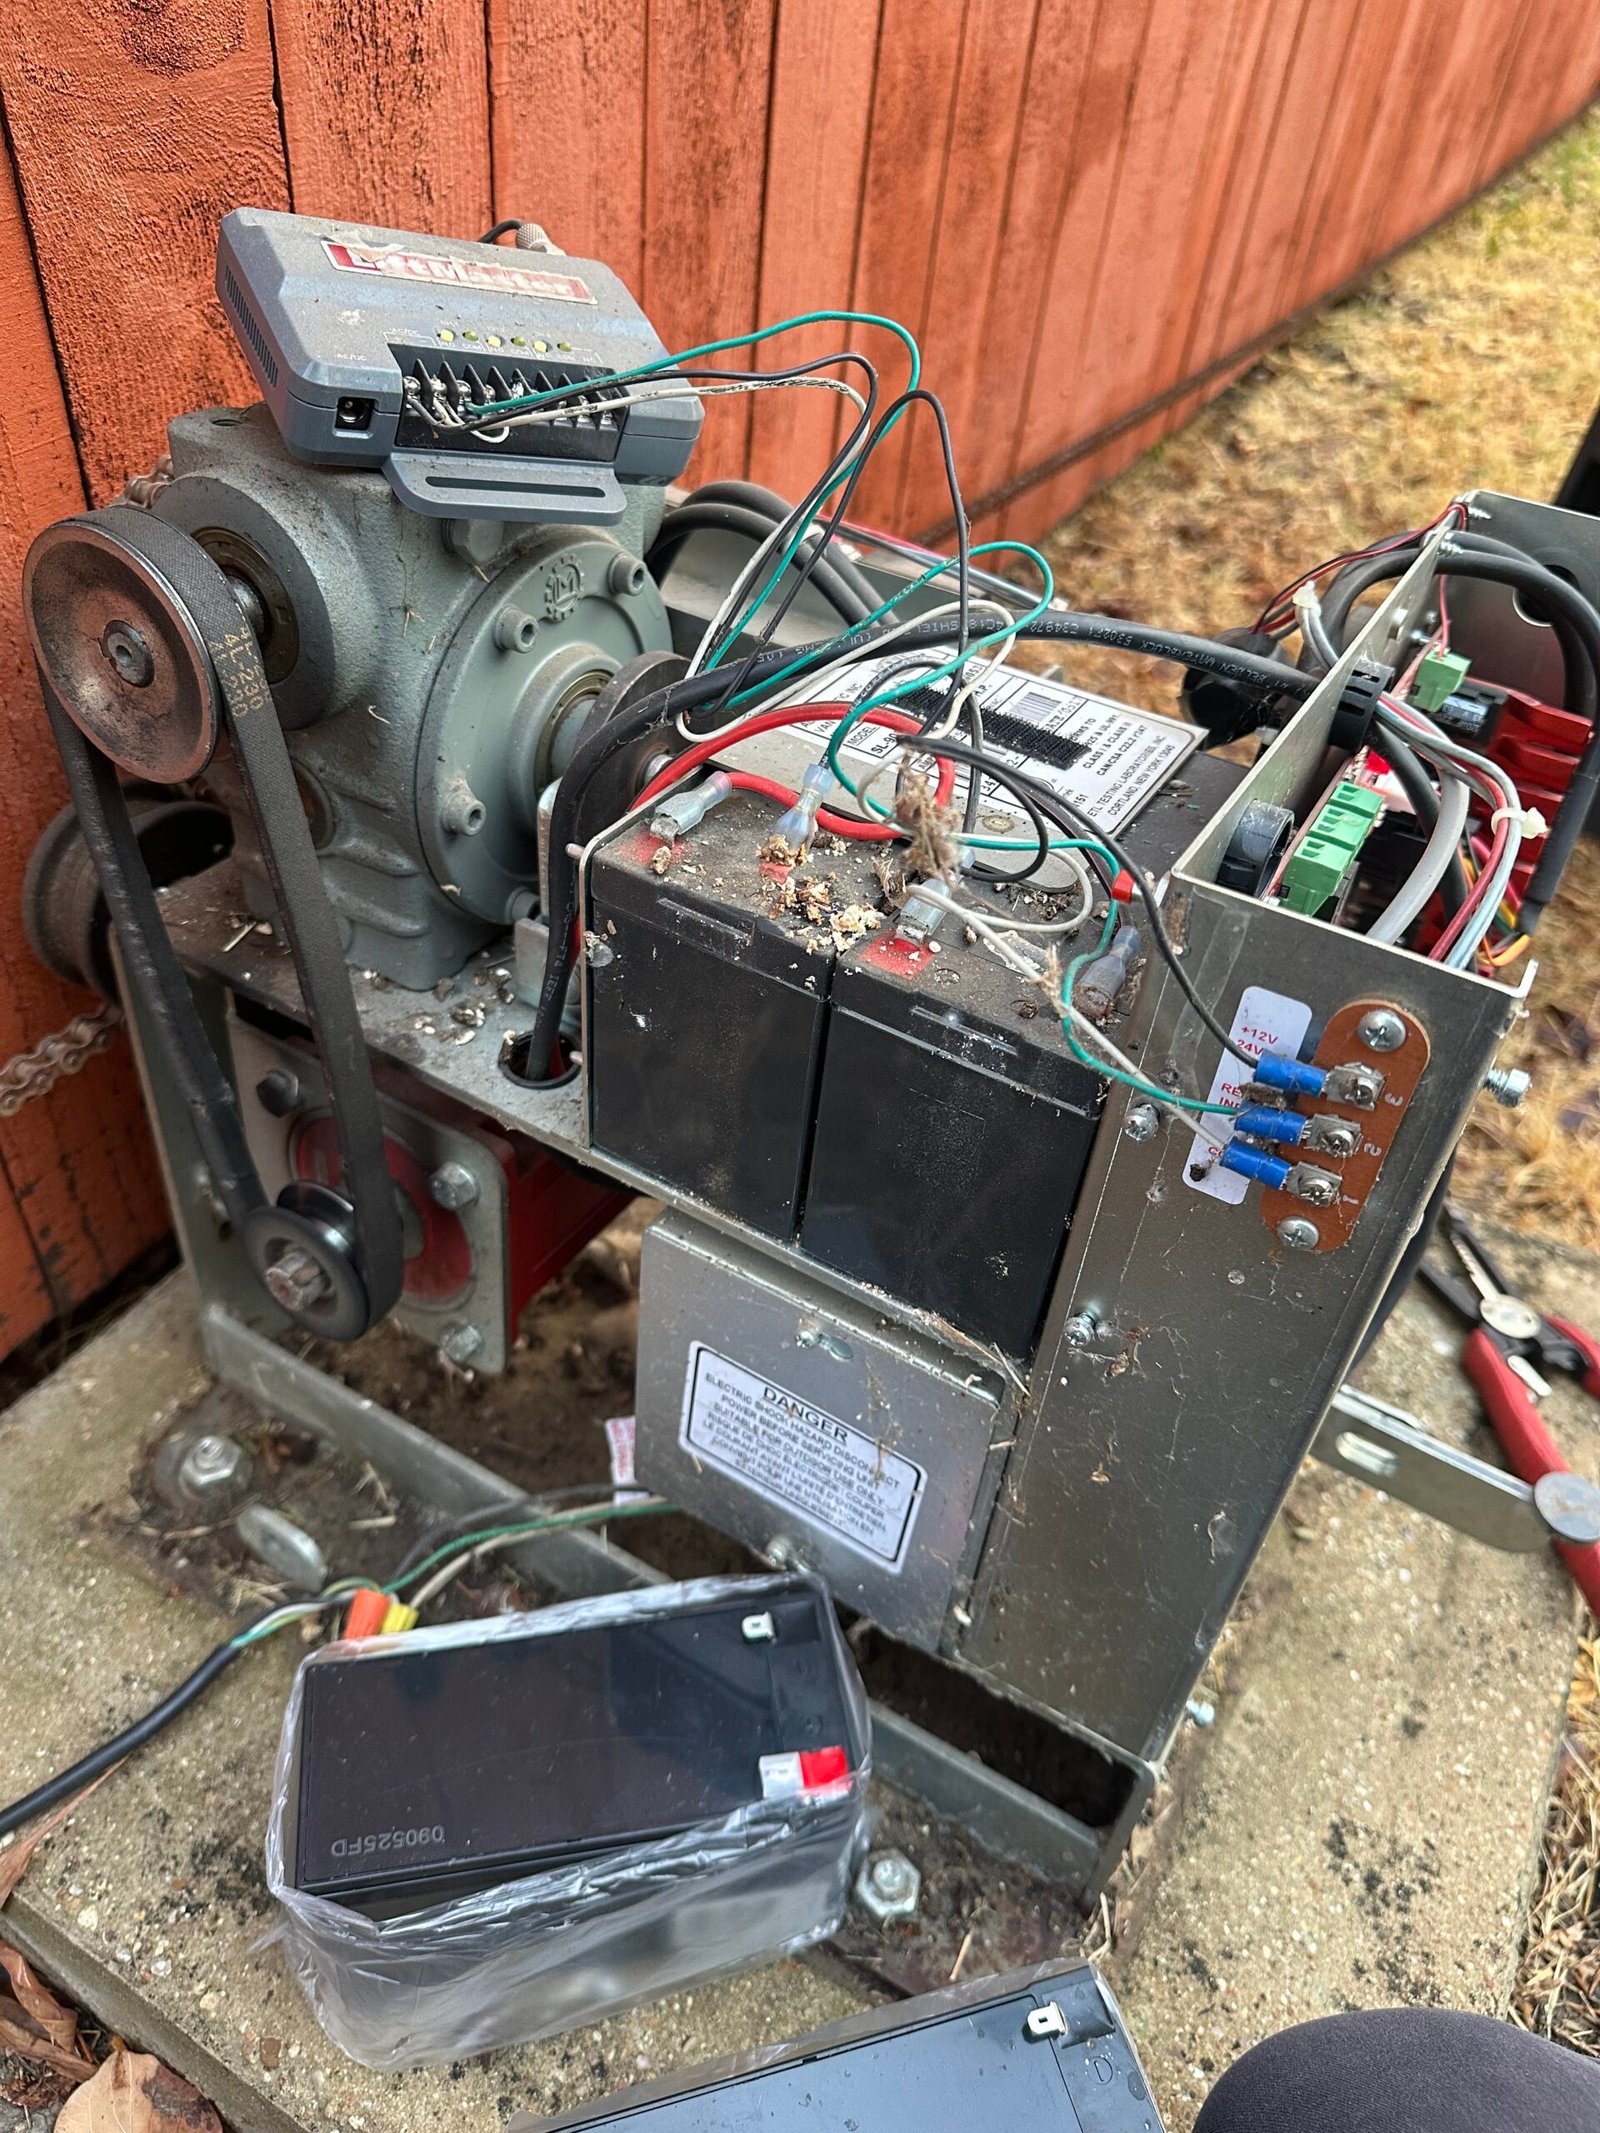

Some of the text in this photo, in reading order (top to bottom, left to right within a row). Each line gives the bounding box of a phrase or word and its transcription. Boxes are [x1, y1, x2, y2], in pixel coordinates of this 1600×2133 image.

[1096, 783, 1123, 805] TESTING
[1240, 1025, 1279, 1045] +12V
[1384, 1092, 1404, 1108] 3
[1363, 1142, 1383, 1158] 2
[705, 1372, 751, 1407] ELECTRIC
[791, 1420, 831, 1452] HAZARD
[764, 1386, 847, 1444] DANGER
[721, 1394, 756, 1421] POWER
[760, 1415, 798, 1445] BEFORE
[801, 1438, 854, 1477] SERVICING
[328, 1824, 445, 1858] 090525FD
